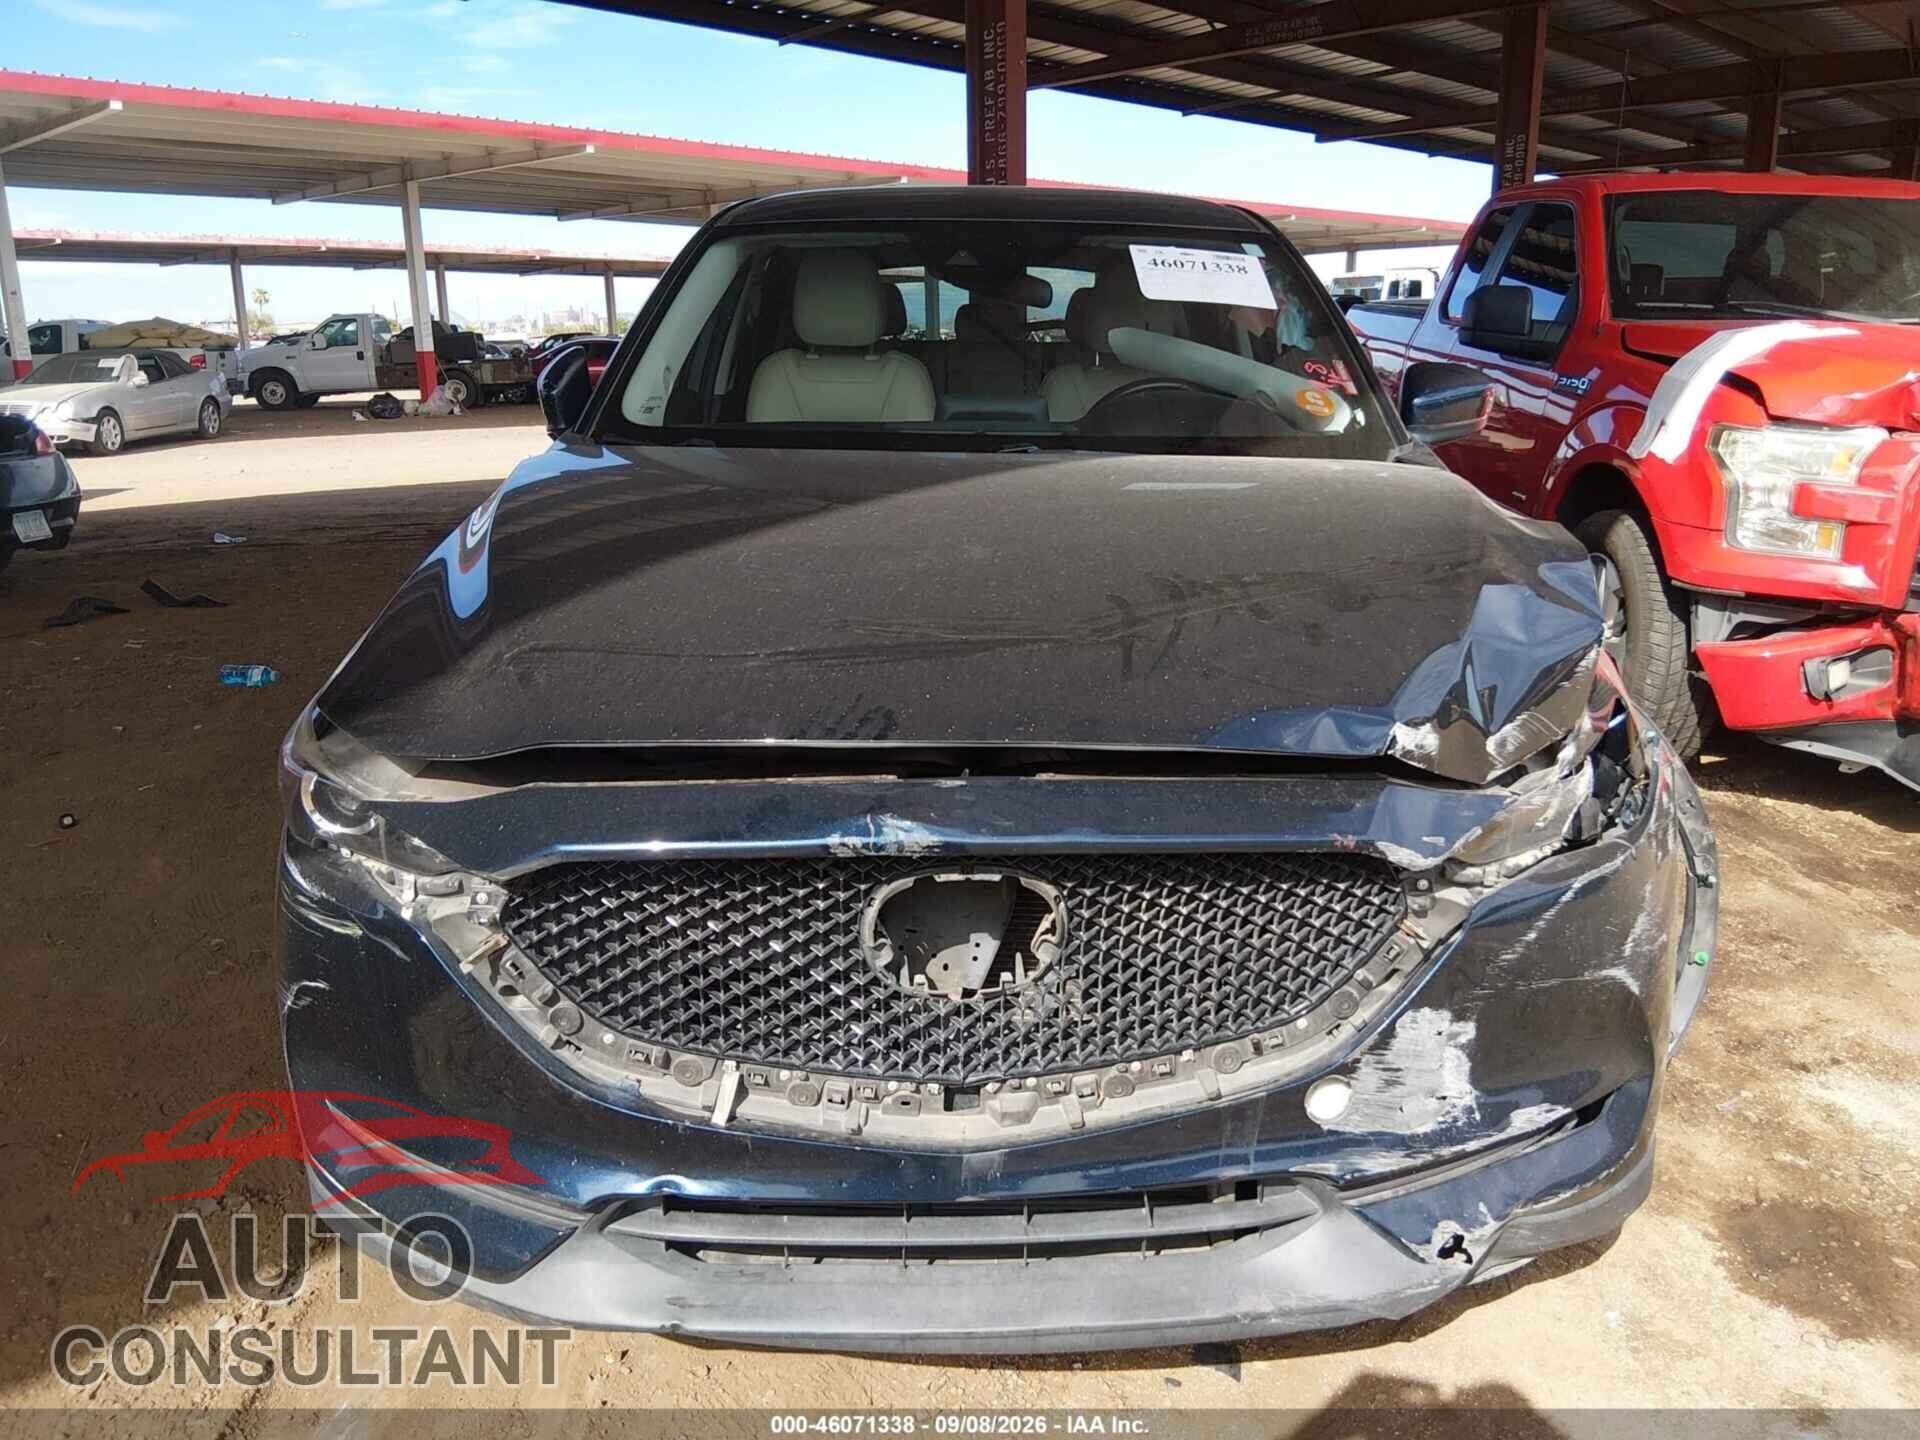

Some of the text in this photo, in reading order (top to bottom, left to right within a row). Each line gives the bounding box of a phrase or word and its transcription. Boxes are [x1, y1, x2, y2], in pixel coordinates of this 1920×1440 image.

[983, 22, 995, 63] INC.
[984, 69, 996, 143] PREFAB
[1147, 257, 1249, 275] 46071338
